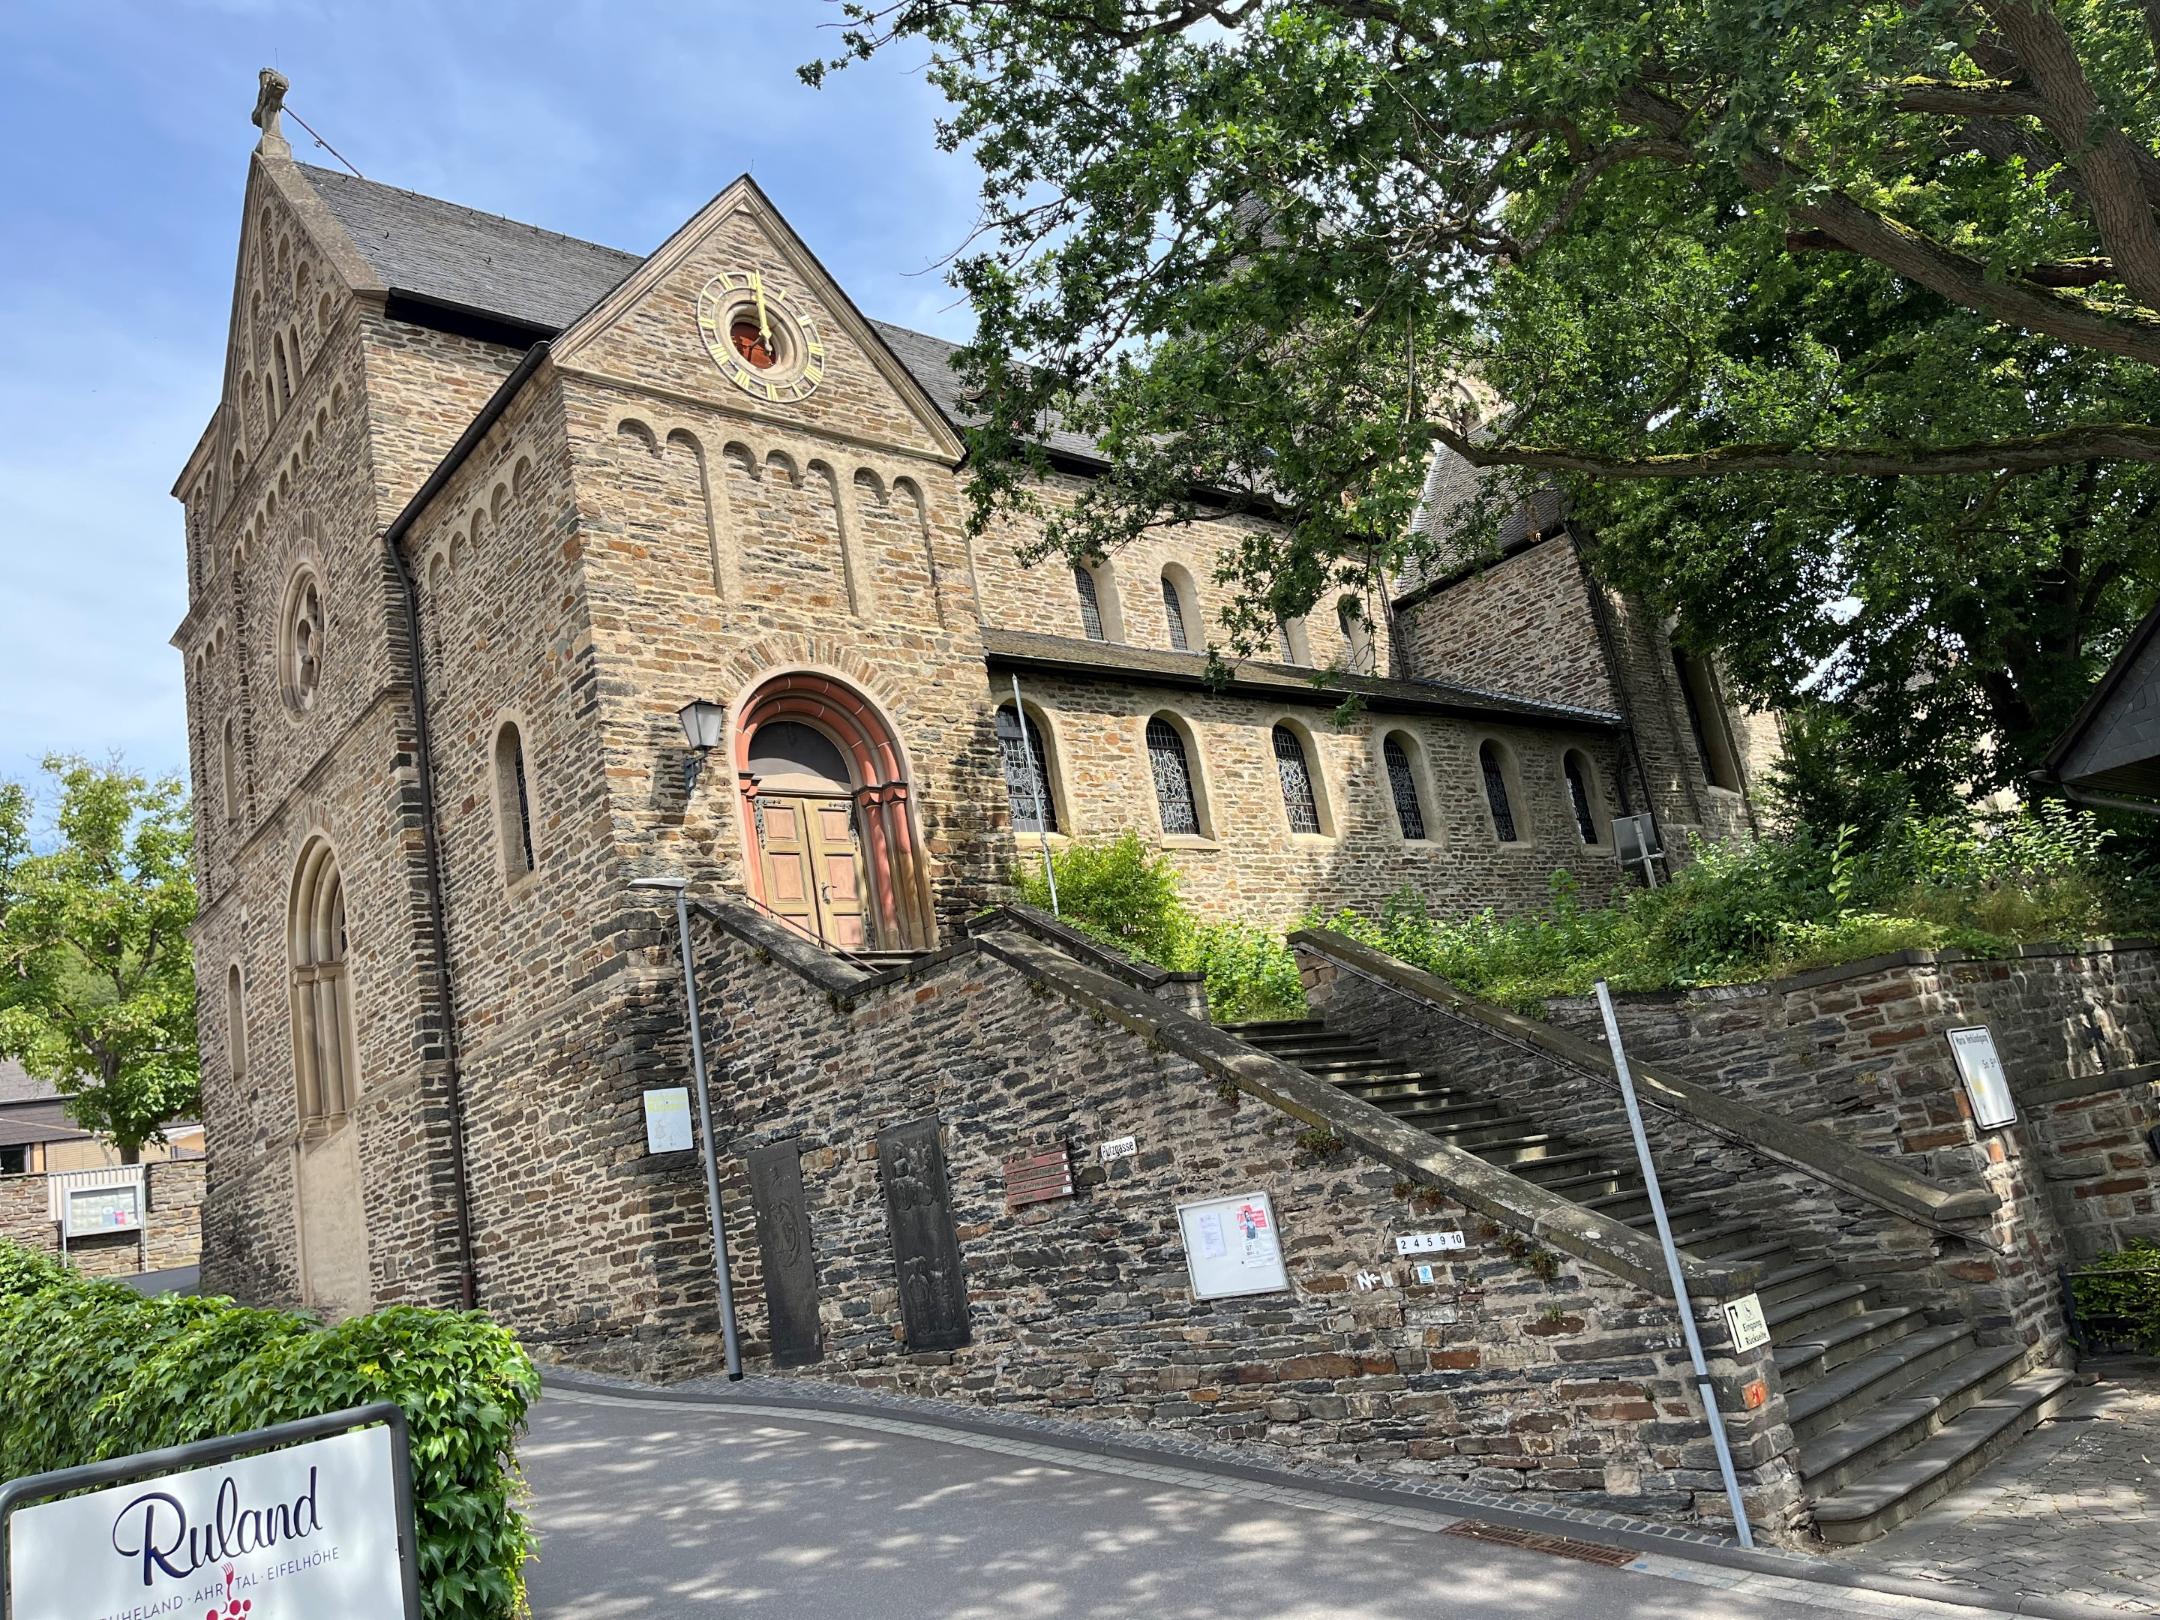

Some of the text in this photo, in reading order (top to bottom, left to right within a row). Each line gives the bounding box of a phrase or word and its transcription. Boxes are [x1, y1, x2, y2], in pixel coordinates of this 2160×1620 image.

[1401, 1234, 1462, 1250] 2 4 5 9 10
[112, 1466, 323, 1586] Ruland
[100, 1547, 340, 1620] HELAND AHR TAL EIFELHÖHE
